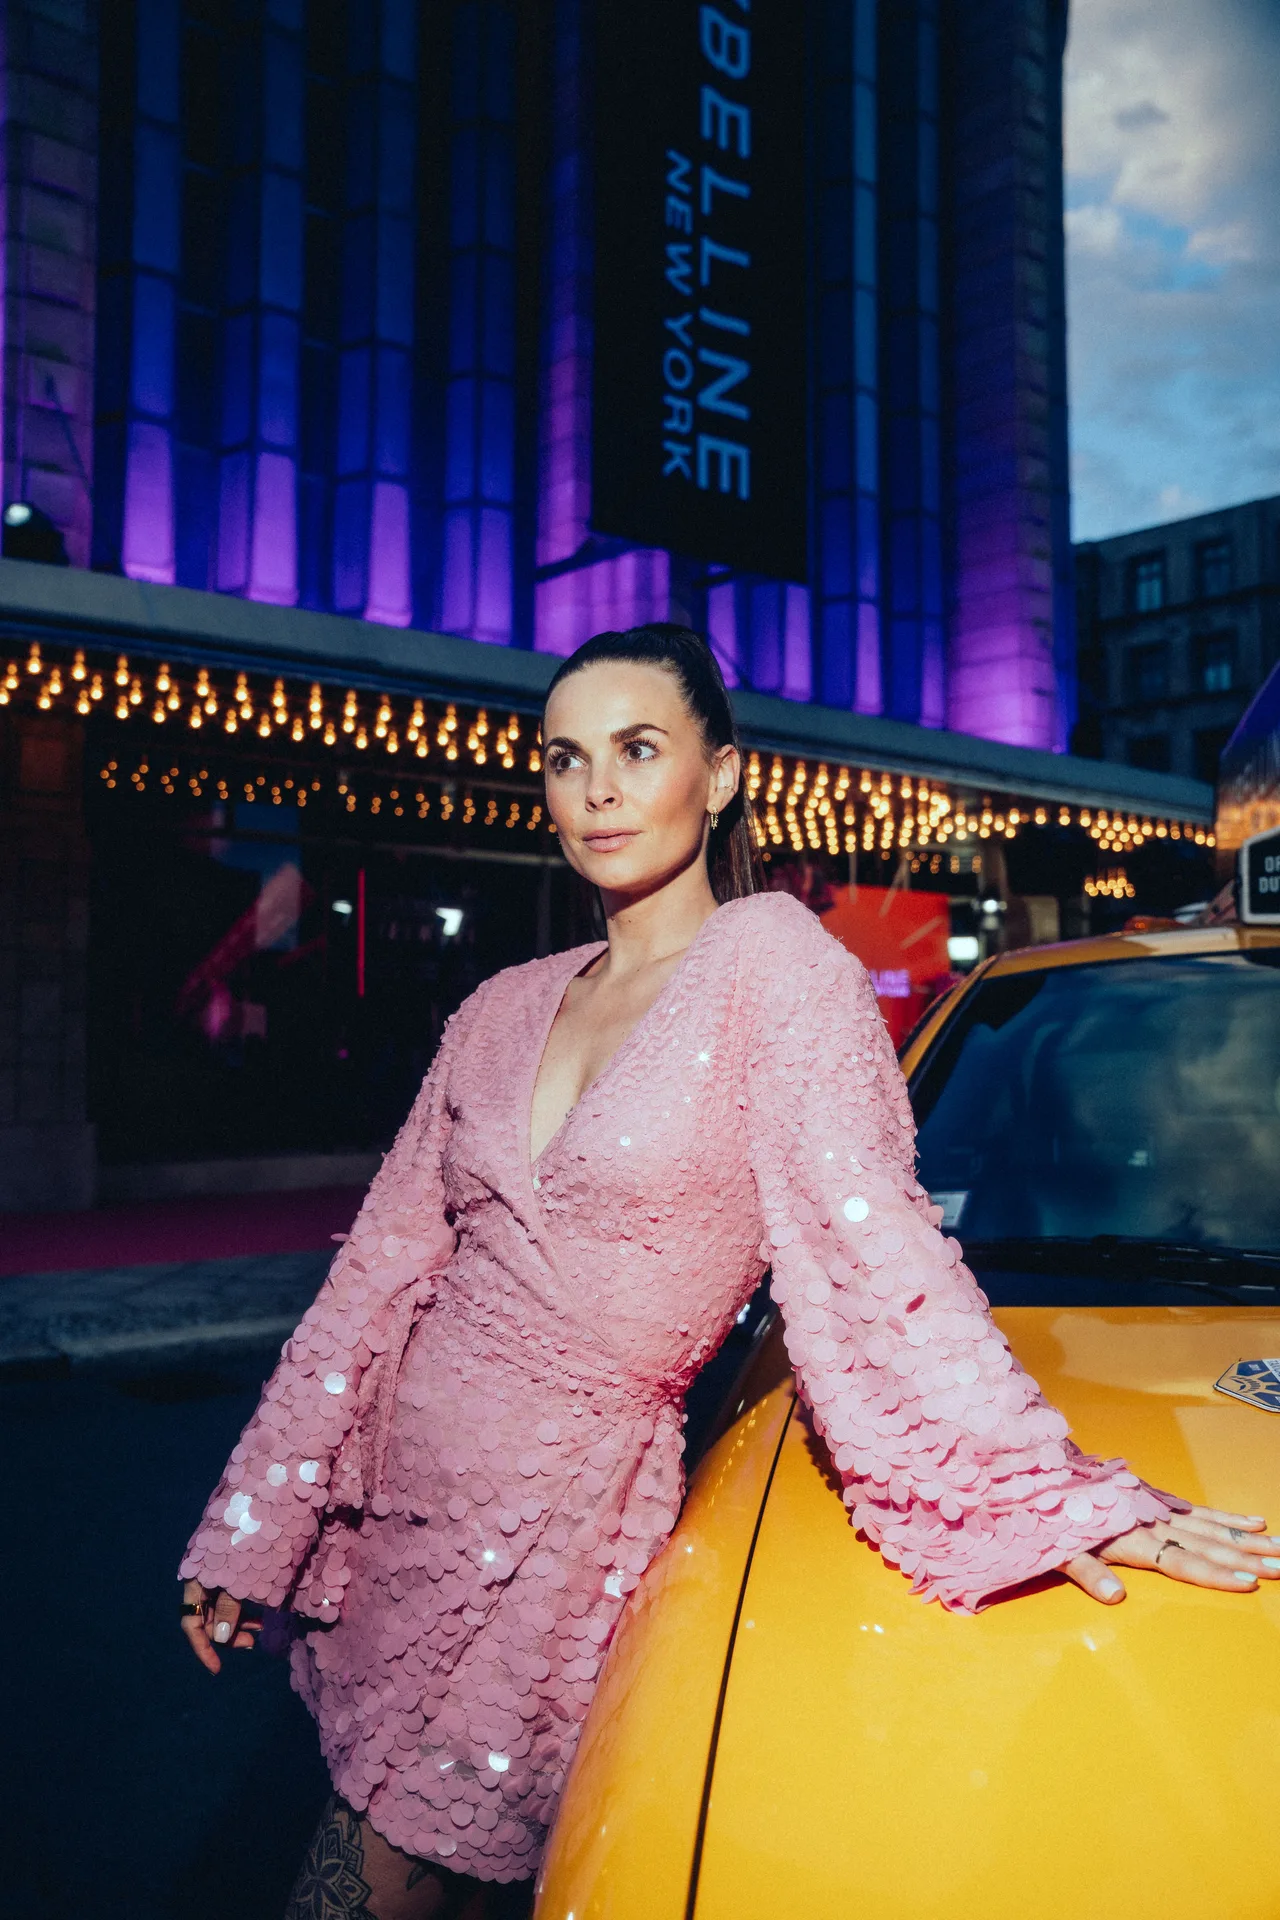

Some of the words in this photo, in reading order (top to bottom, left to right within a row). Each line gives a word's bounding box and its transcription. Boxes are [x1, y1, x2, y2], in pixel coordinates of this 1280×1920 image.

[663, 149, 693, 296] NEW
[699, 0, 751, 500] BELLINE
[662, 311, 694, 479] YORK
[1258, 876, 1280, 894] DU
